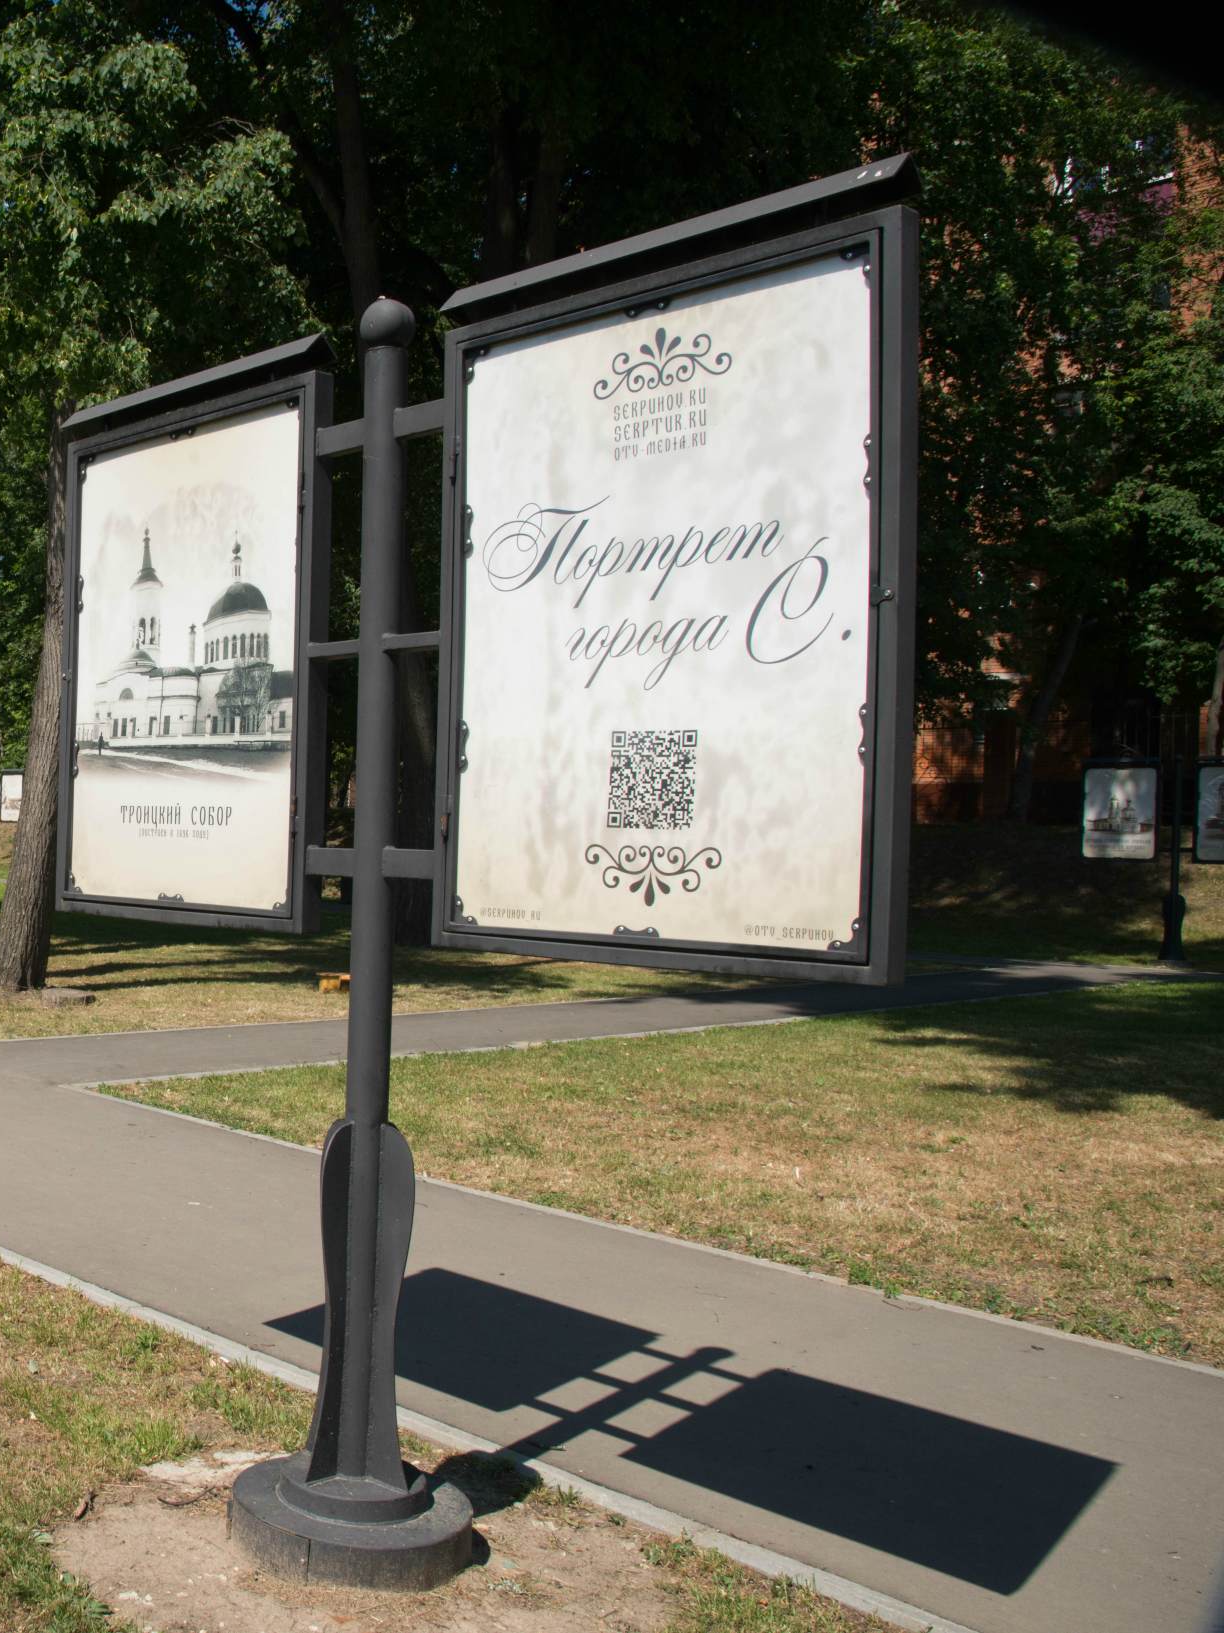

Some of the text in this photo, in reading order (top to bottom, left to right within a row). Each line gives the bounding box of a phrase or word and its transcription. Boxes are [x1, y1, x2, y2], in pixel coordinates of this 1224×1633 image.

[613, 387, 706, 421] SERPUHOV.RU
[614, 409, 707, 442] SERPTUR.RU
[482, 495, 785, 608] Портрет
[565, 614, 729, 691] города
[120, 803, 233, 828] ТРОИЦКИЙ СОБОР
